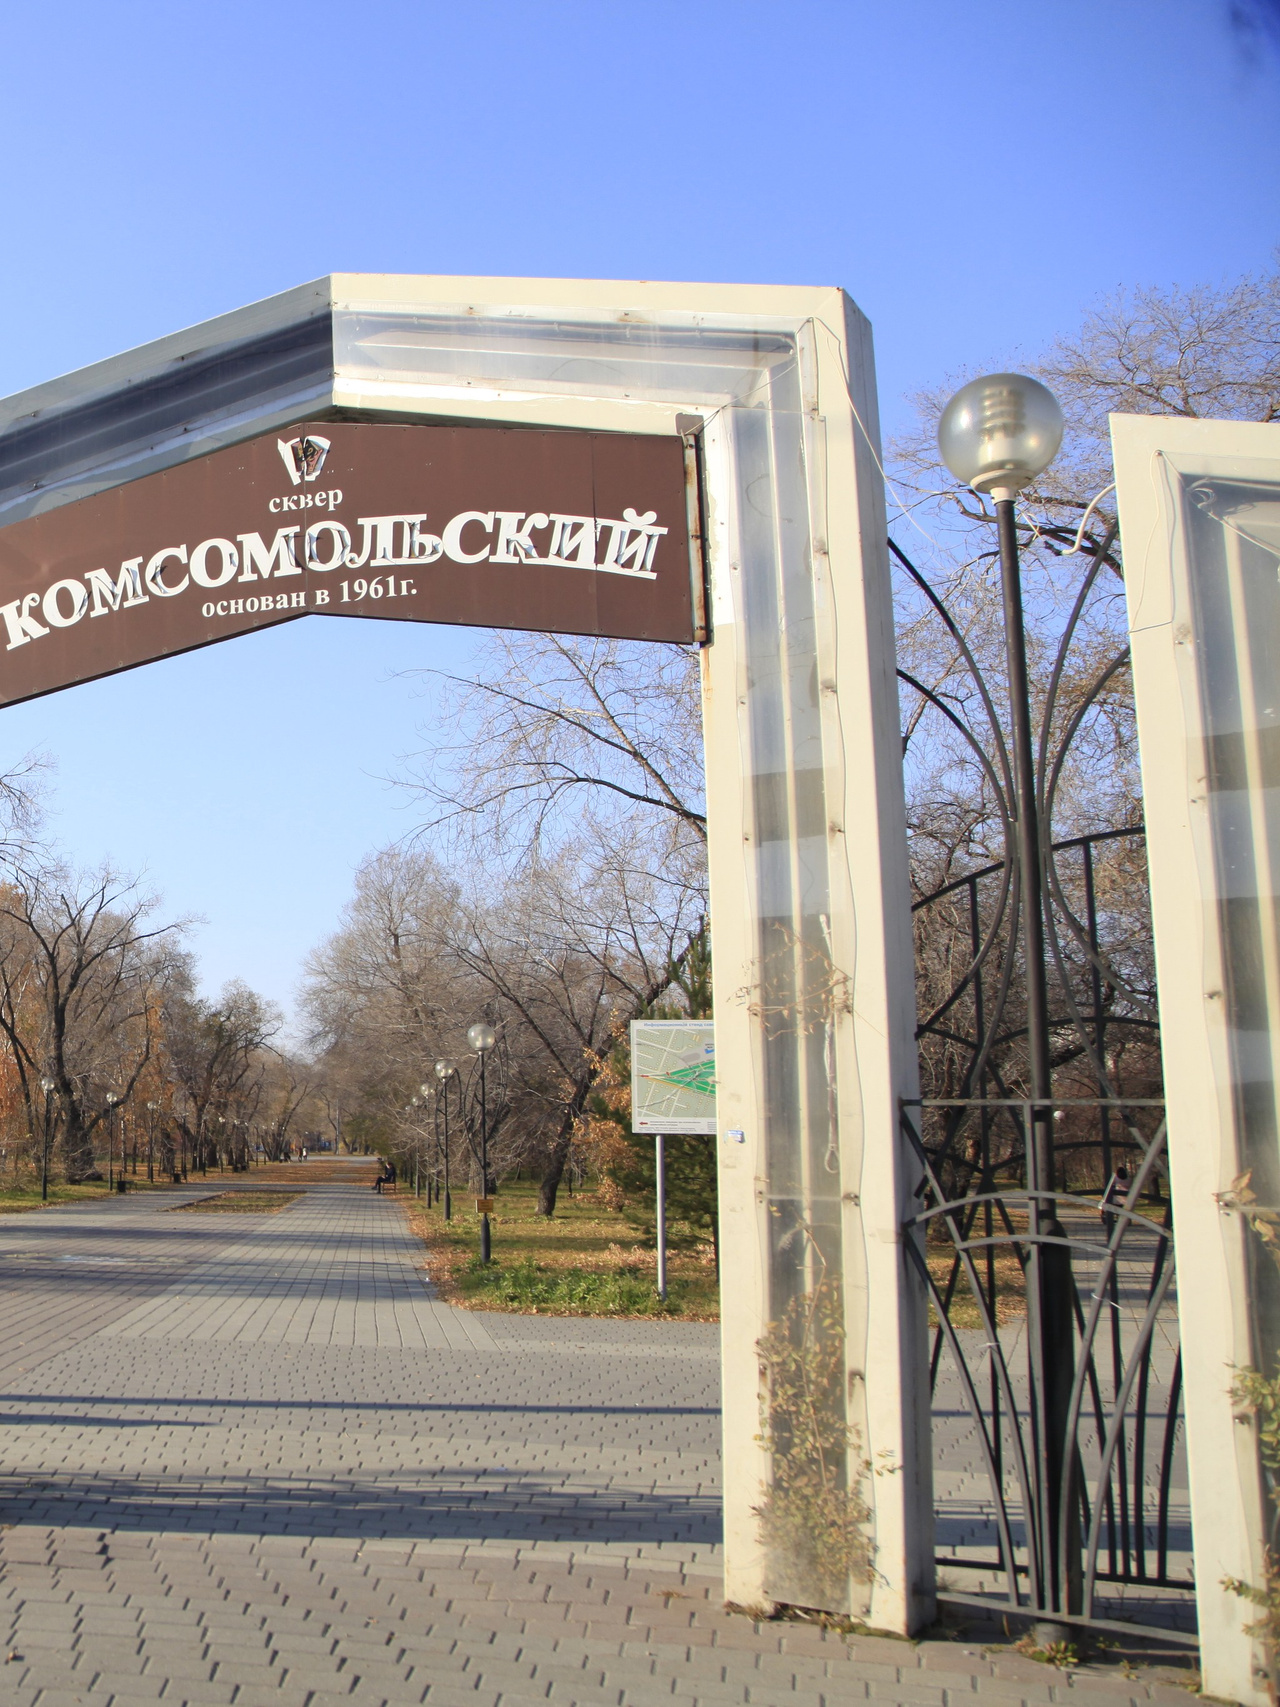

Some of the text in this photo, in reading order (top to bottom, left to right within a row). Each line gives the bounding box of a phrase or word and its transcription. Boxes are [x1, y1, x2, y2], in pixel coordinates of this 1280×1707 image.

[268, 488, 343, 513] сквер
[201, 575, 418, 618] основан в 1961г.
